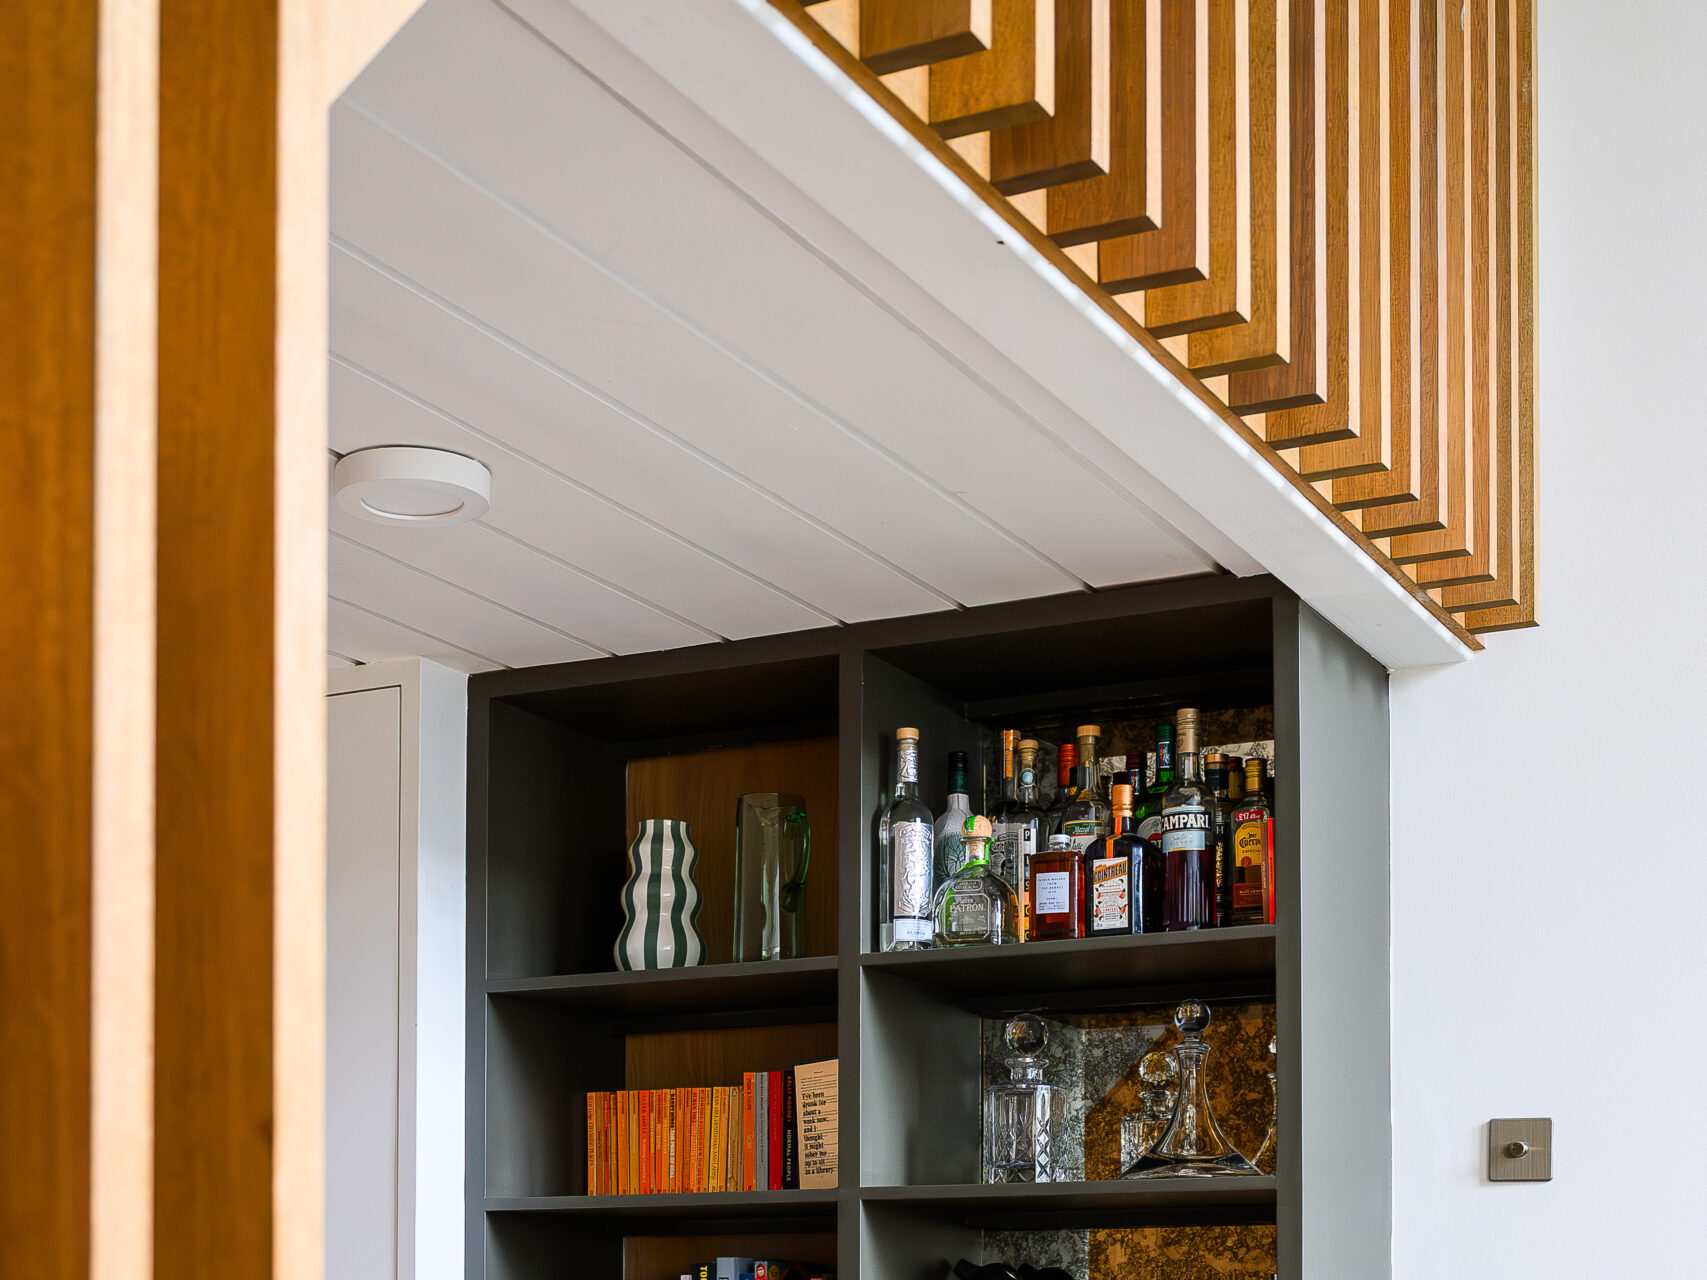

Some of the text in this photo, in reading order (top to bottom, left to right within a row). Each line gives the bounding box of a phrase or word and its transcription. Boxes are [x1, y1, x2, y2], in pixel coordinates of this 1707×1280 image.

[1161, 814, 1209, 831] AMPARI
[1094, 862, 1127, 882] COINTREAU
[802, 1100, 818, 1109] drunk
[803, 1109, 817, 1117] about
[803, 1125, 813, 1133] and
[803, 1134, 824, 1142] thought
[809, 1143, 824, 1151] might
